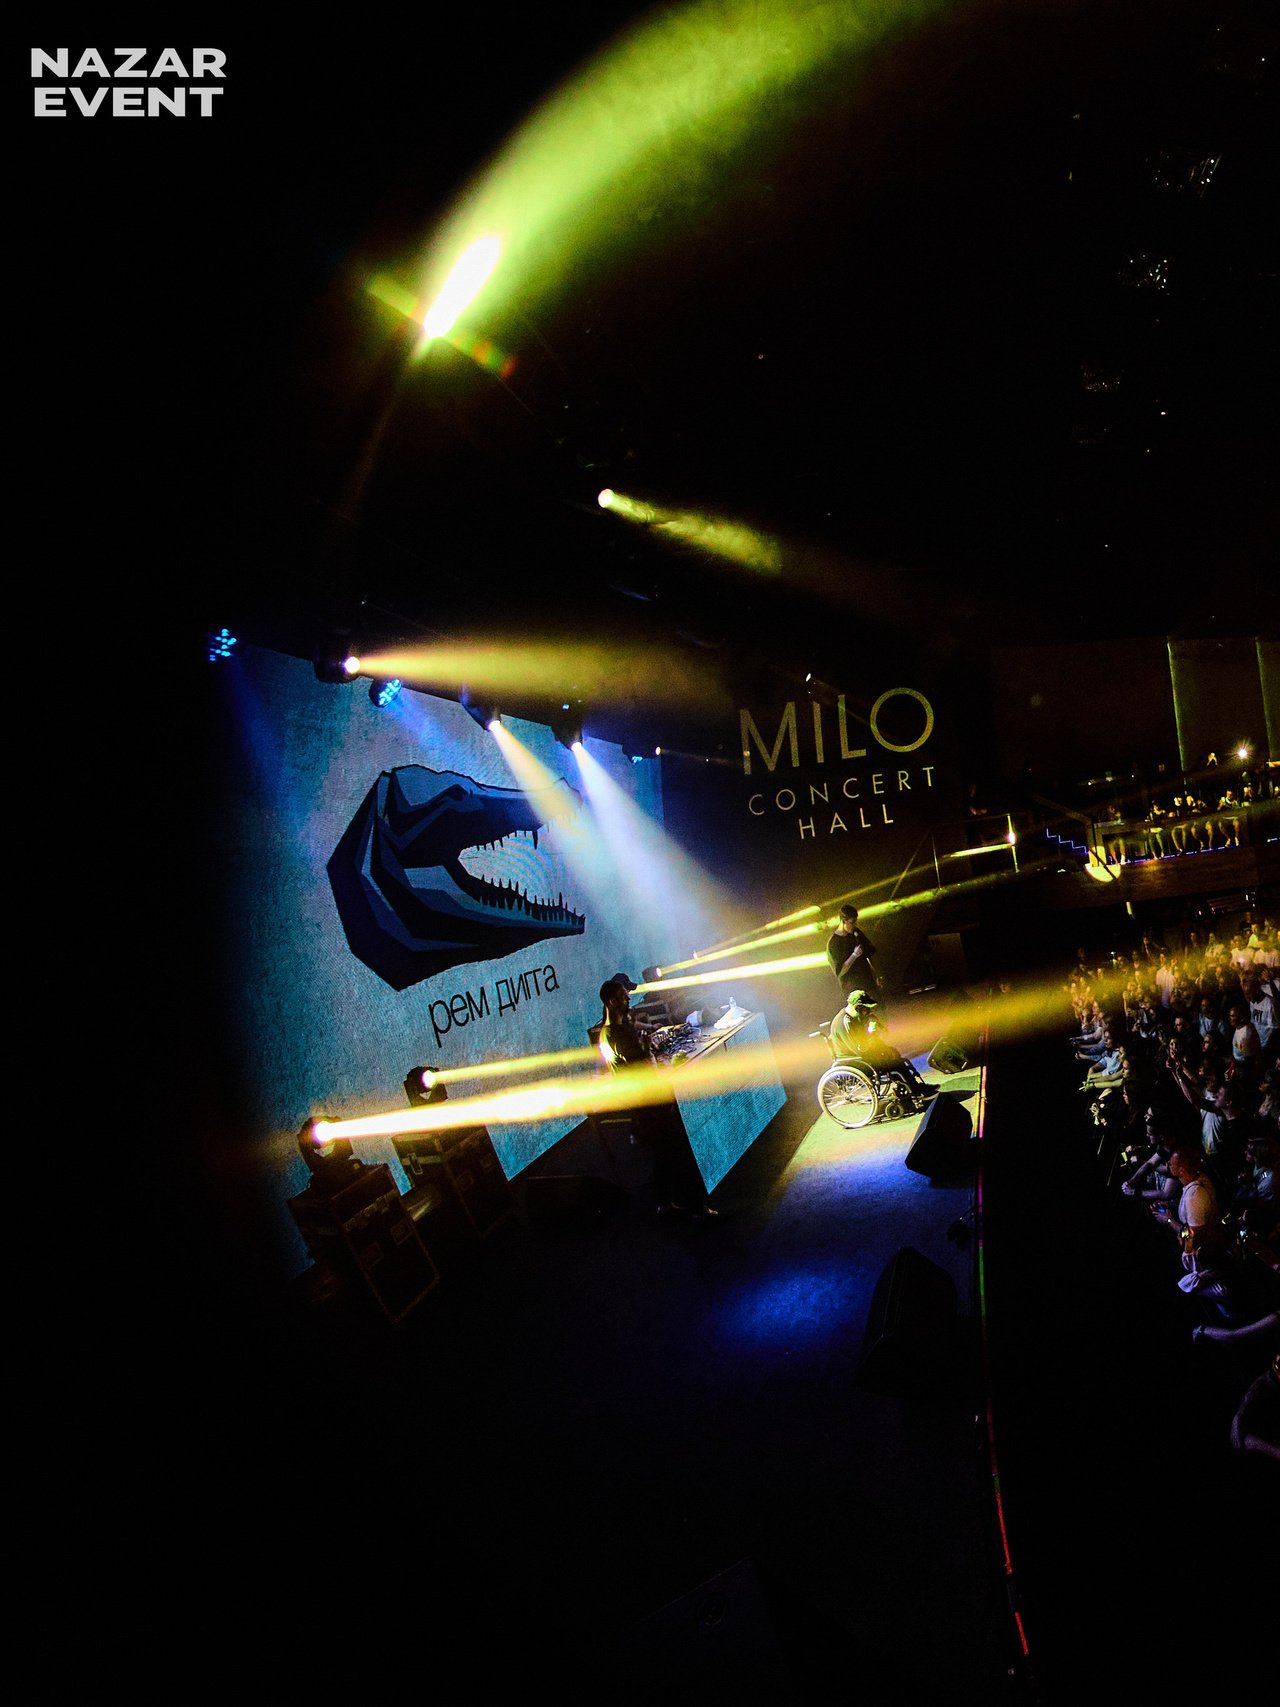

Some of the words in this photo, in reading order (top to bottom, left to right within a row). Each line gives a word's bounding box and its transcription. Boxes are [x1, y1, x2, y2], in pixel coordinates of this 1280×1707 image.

[740, 687, 934, 775] MILO
[748, 766, 935, 815] CONCERT
[798, 803, 894, 839] HALL
[428, 986, 491, 1048] рем
[495, 964, 560, 1017] дигга
